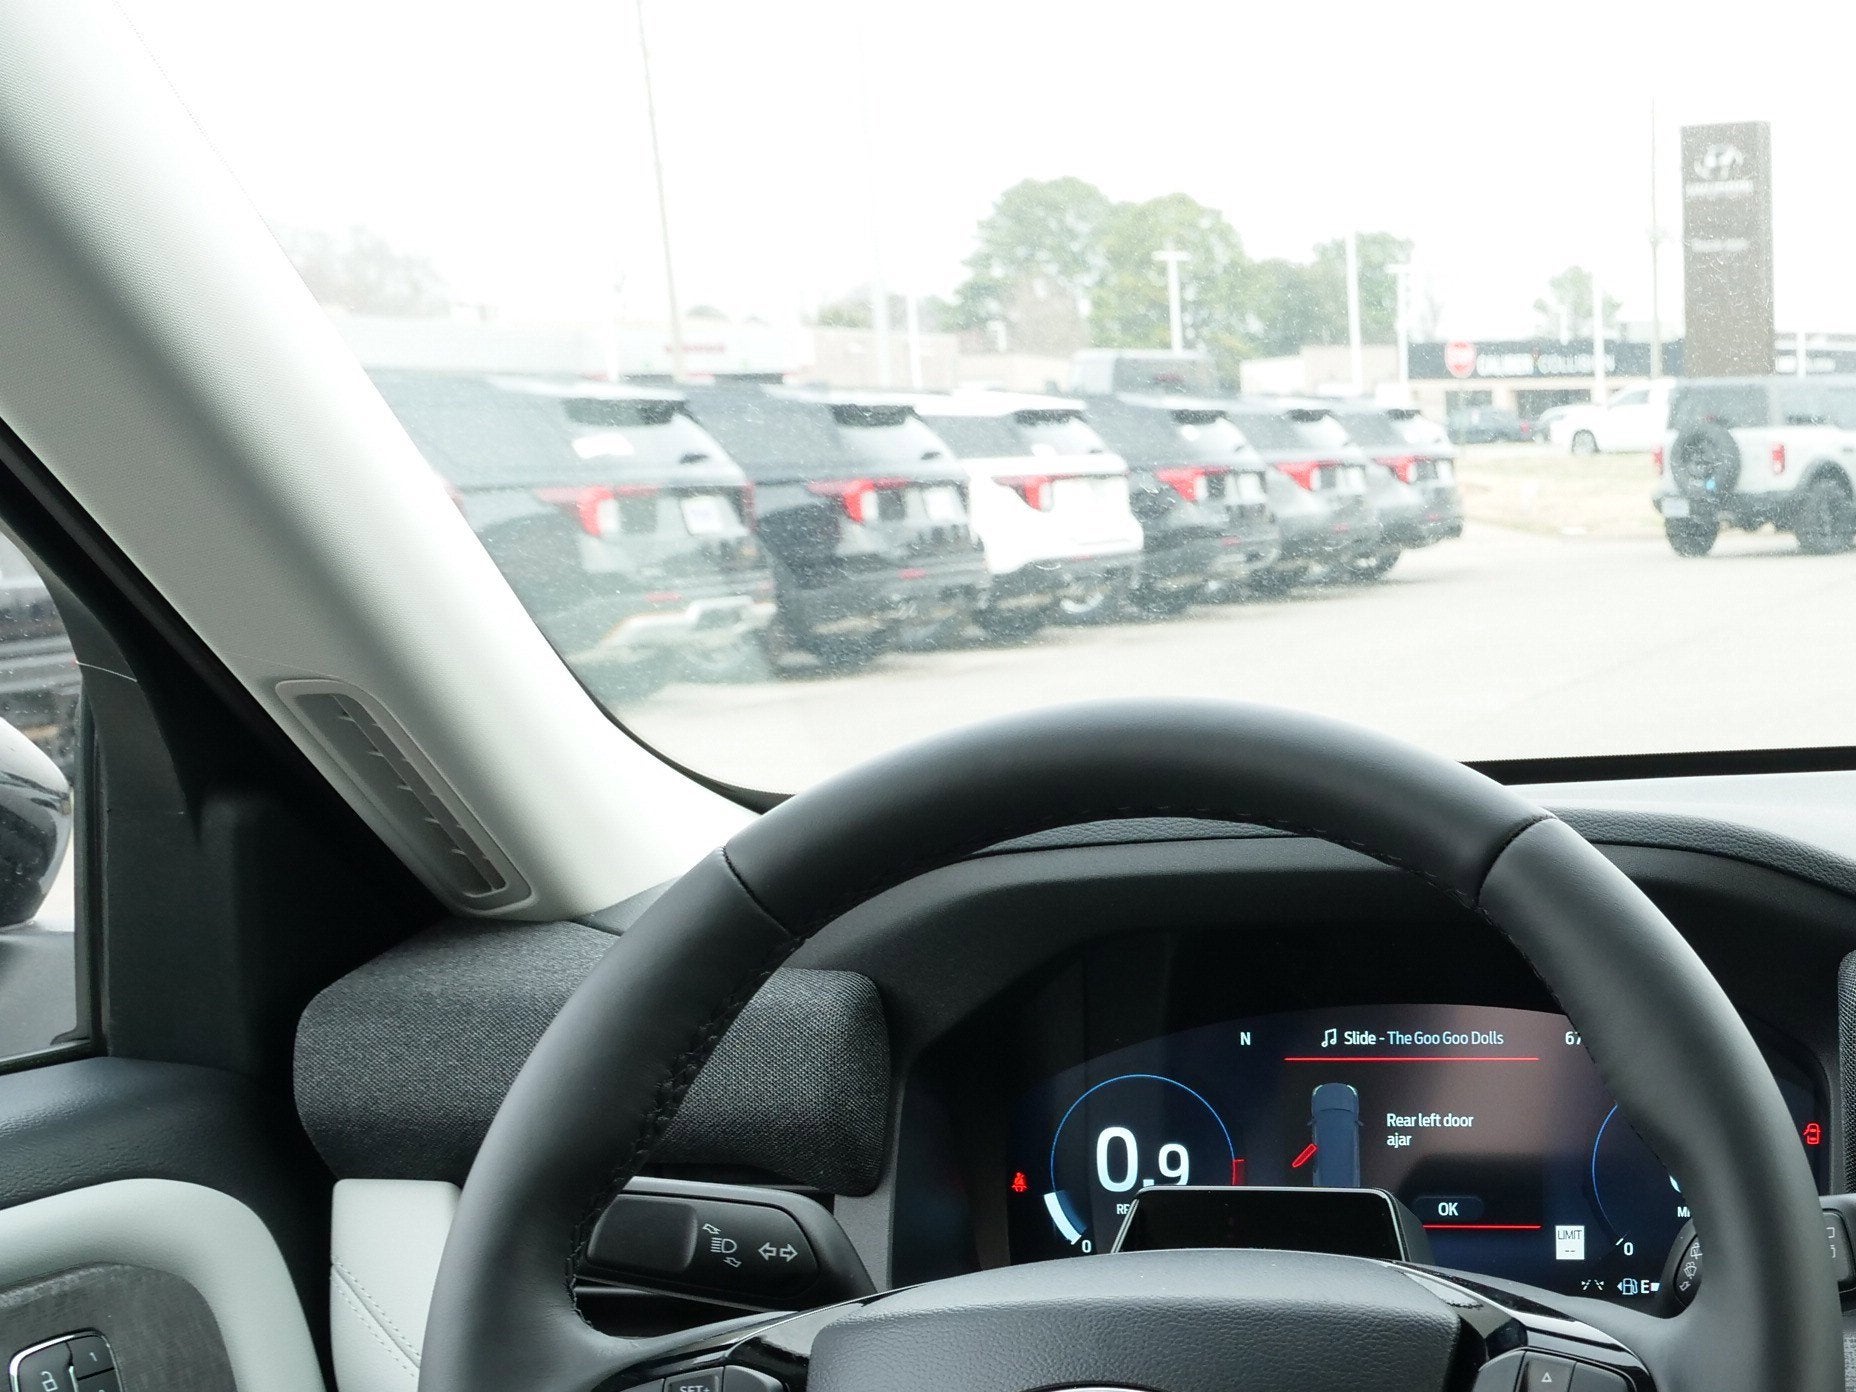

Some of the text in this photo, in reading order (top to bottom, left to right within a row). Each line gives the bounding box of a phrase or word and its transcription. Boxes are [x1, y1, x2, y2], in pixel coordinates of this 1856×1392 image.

[1240, 1031, 1251, 1046] N
[1344, 1030, 1376, 1046] Slide
[1387, 1030, 1412, 1045] The
[1414, 1030, 1440, 1045] Goo
[1442, 1030, 1468, 1045] Goo
[1470, 1030, 1504, 1045] Dolls
[1386, 1113, 1474, 1127] Rear left door
[1387, 1132, 1412, 1148] ajar
[1096, 1126, 1190, 1192] 0.9
[1438, 1202, 1459, 1216] OK
[1557, 1229, 1582, 1240] LIMIT
[1081, 1240, 1092, 1254] 0
[1623, 1241, 1634, 1256] 0
[1640, 1279, 1650, 1294] E
[89, 1351, 98, 1362] 1
